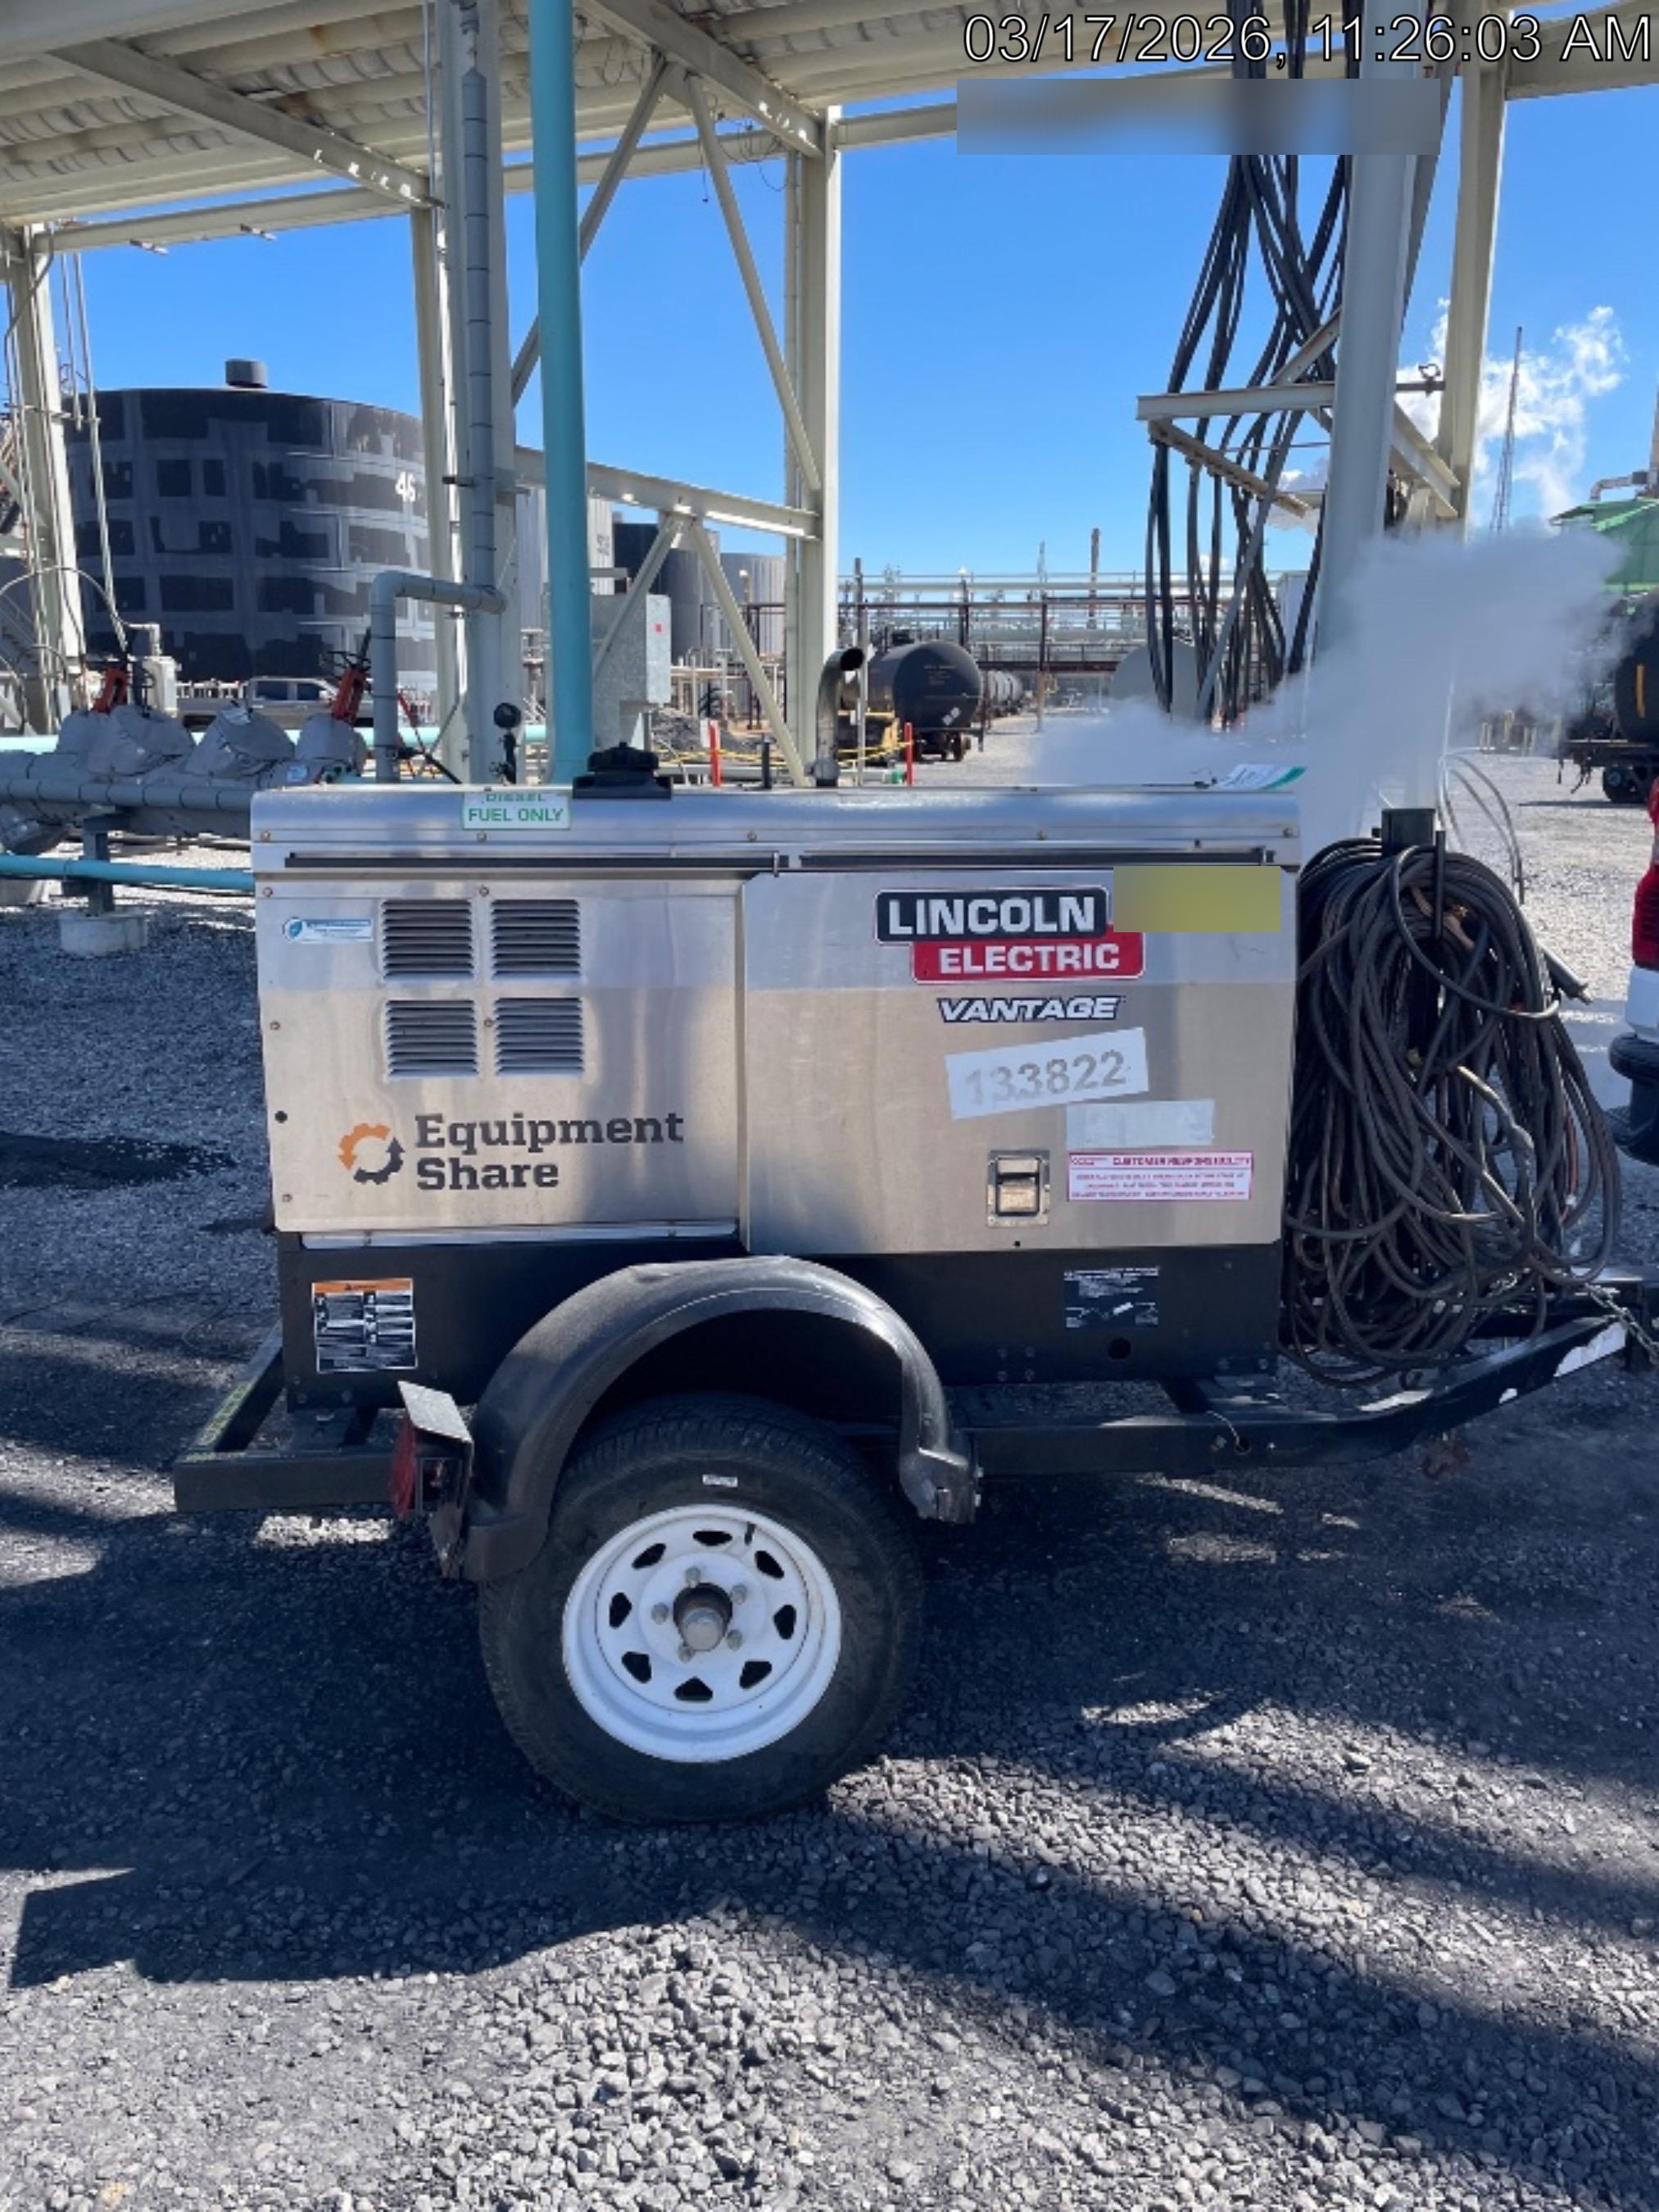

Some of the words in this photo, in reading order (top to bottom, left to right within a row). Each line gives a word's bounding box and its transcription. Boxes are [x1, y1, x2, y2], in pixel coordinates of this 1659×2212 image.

[469, 807, 512, 822] FUEL
[518, 807, 564, 822] ONLY
[888, 895, 1095, 936] LINCOLN
[939, 942, 1120, 975] ELECTRIC
[936, 995, 1122, 1023] VANTAGE
[965, 1049, 1127, 1105] 133822
[414, 1112, 685, 1155] Equipment
[416, 1156, 560, 1191] Share
